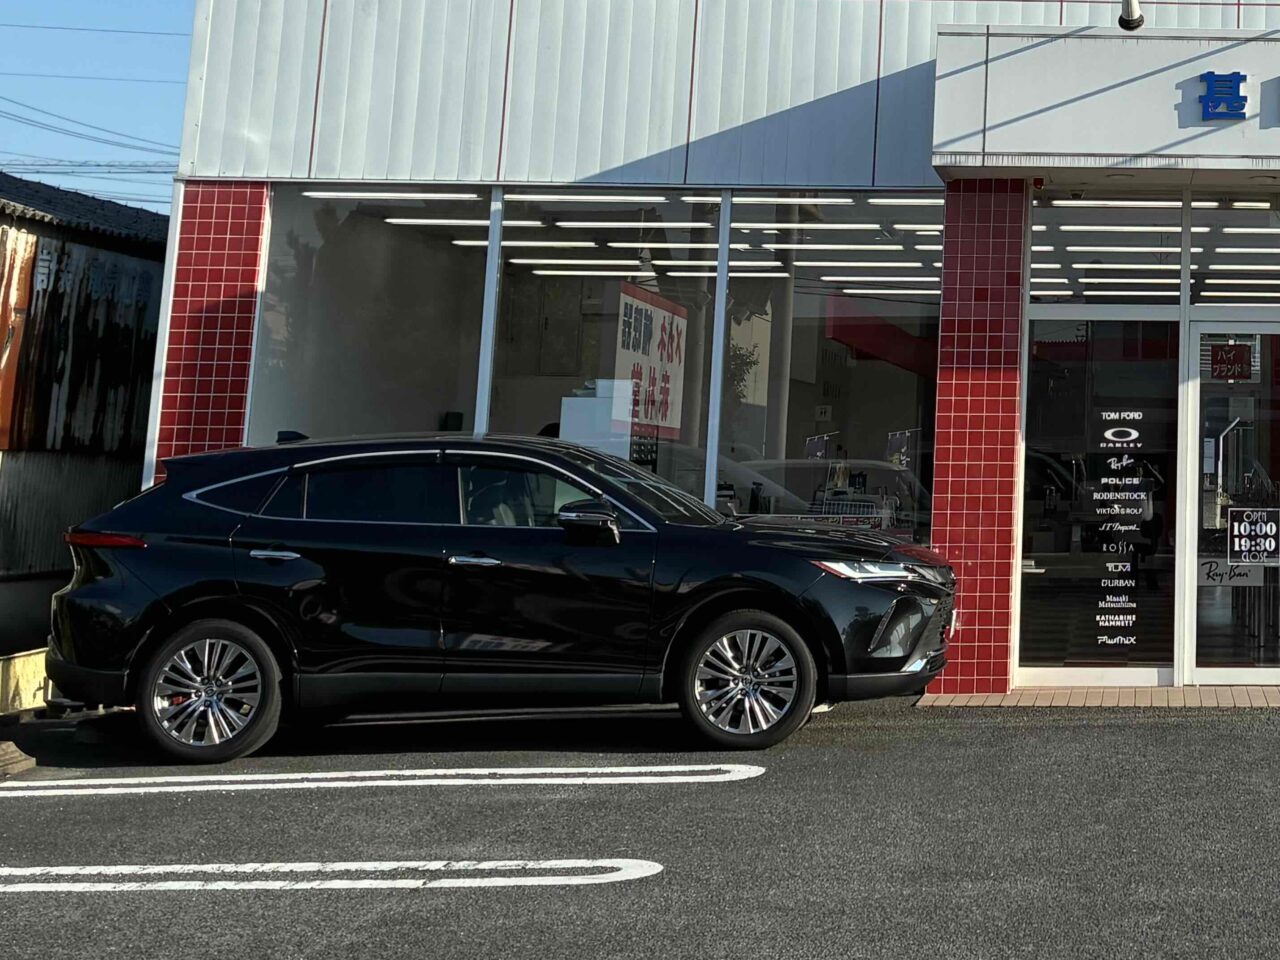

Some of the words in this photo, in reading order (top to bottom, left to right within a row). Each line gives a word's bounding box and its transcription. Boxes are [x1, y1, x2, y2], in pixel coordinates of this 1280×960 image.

[1101, 412, 1119, 420] TOM
[1121, 412, 1142, 420] FORD
[1093, 492, 1147, 500] RODENSTOCK
[1243, 511, 1267, 522] OPEN
[1233, 522, 1277, 536] 10:00
[1102, 541, 1134, 554] ROSSA
[1234, 537, 1276, 551] 19:30
[1241, 551, 1268, 562] CLOSE
[1106, 563, 1131, 572] TUMI
